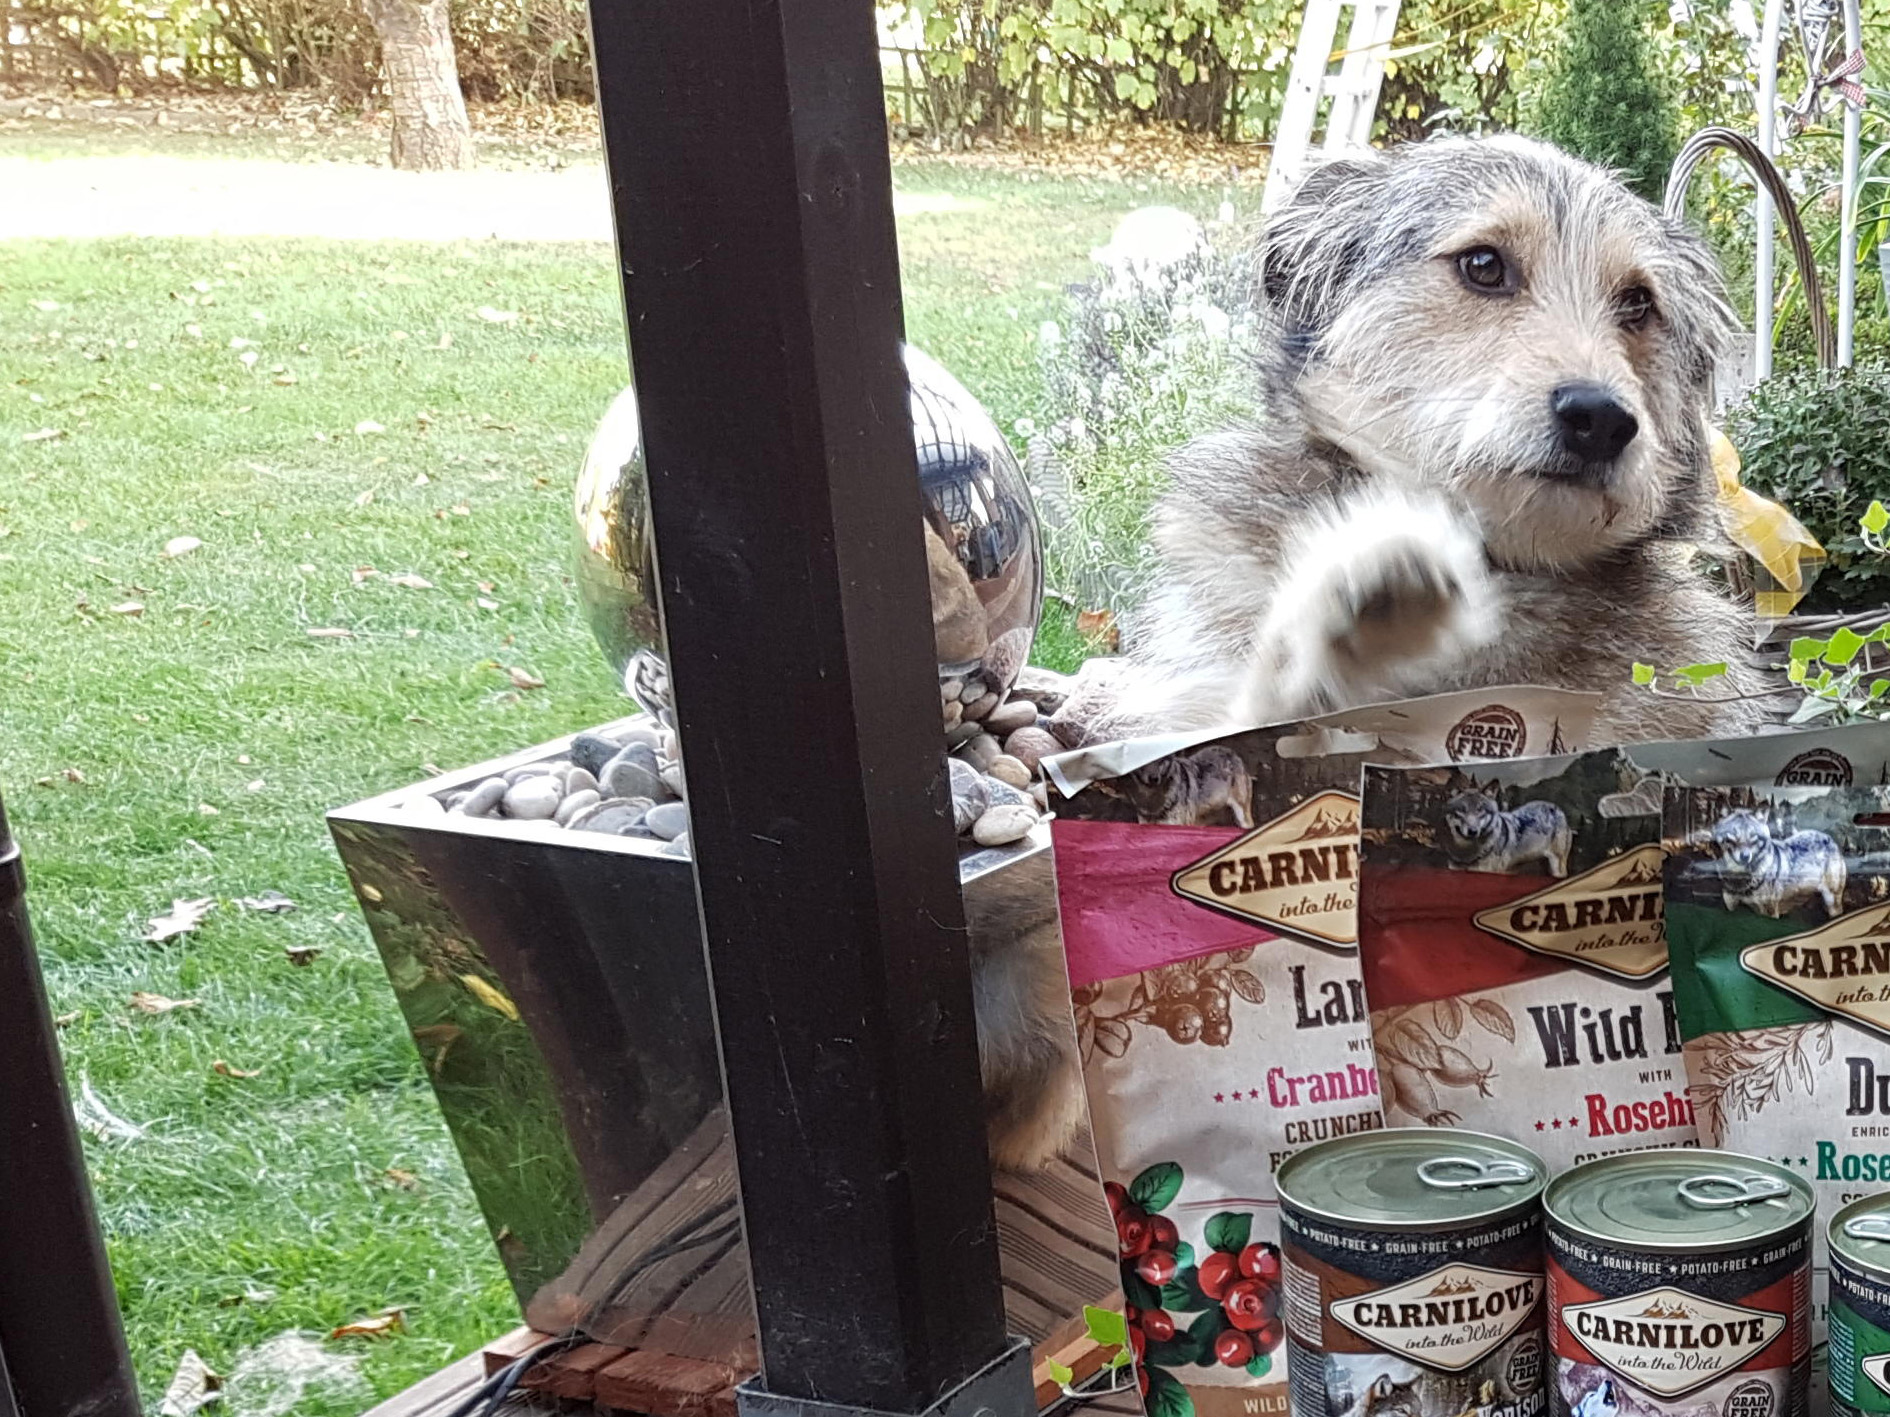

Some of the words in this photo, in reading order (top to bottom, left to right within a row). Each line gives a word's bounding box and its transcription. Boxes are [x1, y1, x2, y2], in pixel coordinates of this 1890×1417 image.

[1460, 720, 1517, 745] GRAIN
[1456, 736, 1518, 758] FREE
[1528, 1003, 1648, 1068] Wild
[1639, 1070, 1672, 1083] WITH
[1386, 1241, 1448, 1254] GRAIN-FREE
[1467, 1225, 1521, 1249] POTATO-FREE
[1603, 1254, 1661, 1275] GRAIN-FREE
[1681, 1257, 1748, 1276] POTATO-FREE
[1354, 1279, 1534, 1328] CARNILOVE
[1577, 1311, 1764, 1350] CARNILOVE
[1617, 1353, 1650, 1370] into
[1651, 1352, 1677, 1371] the
[1673, 1350, 1723, 1372] Wild
[1244, 1396, 1288, 1414] WILD
[1731, 1395, 1769, 1408] GRAIN
